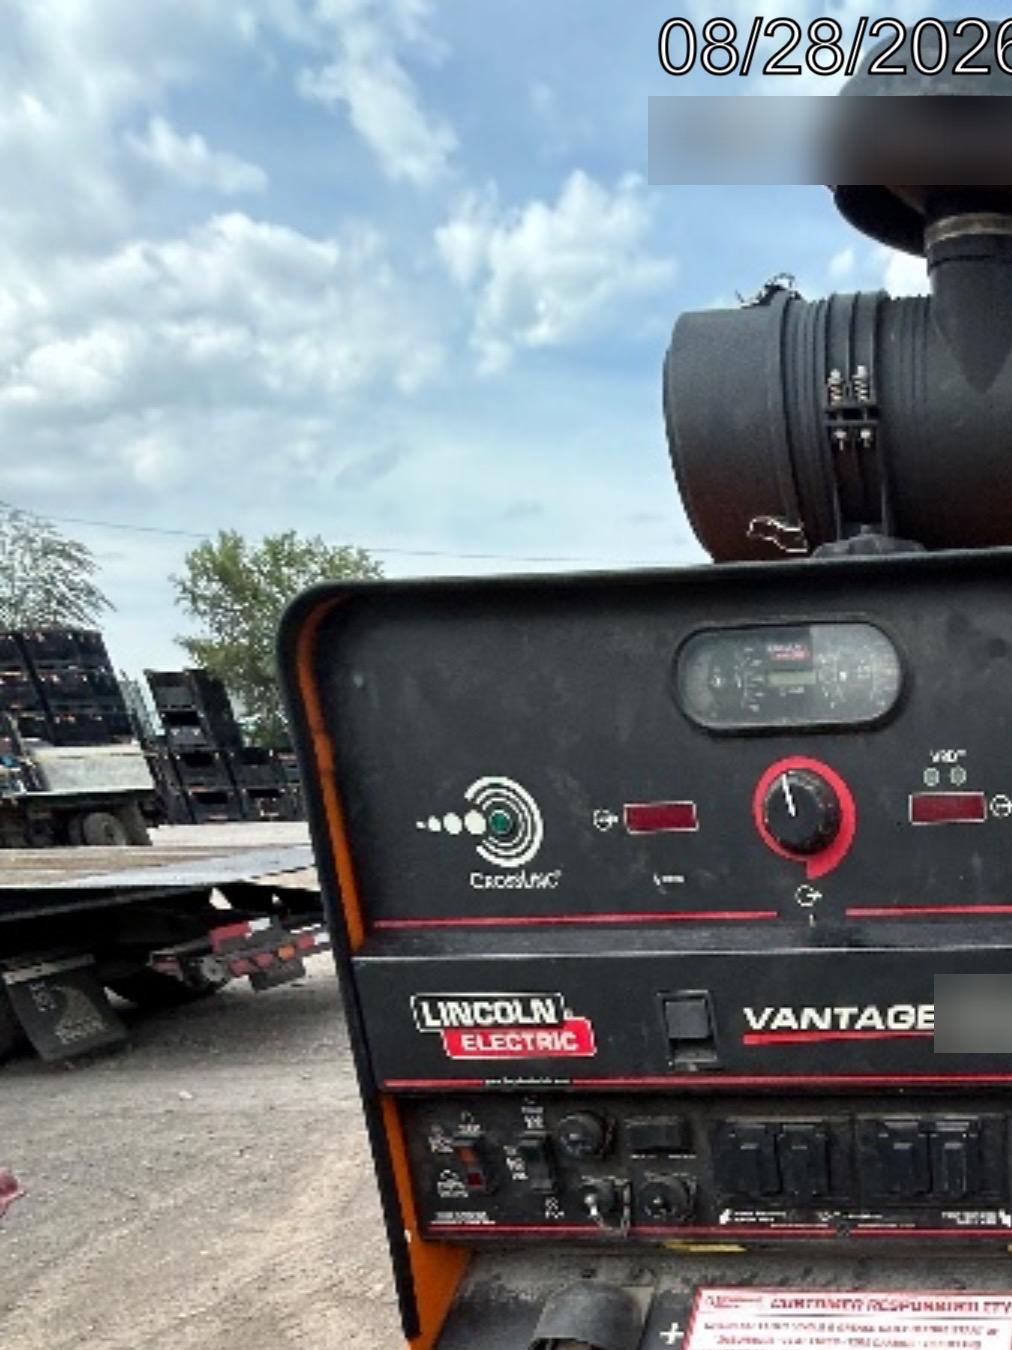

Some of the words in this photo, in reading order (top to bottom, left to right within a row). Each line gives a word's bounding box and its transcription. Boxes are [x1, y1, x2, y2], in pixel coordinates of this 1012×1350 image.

[421, 998, 559, 1027] LINCOLN
[743, 1004, 934, 1030] VANTAGE
[461, 1031, 579, 1052] ELECTRIC
